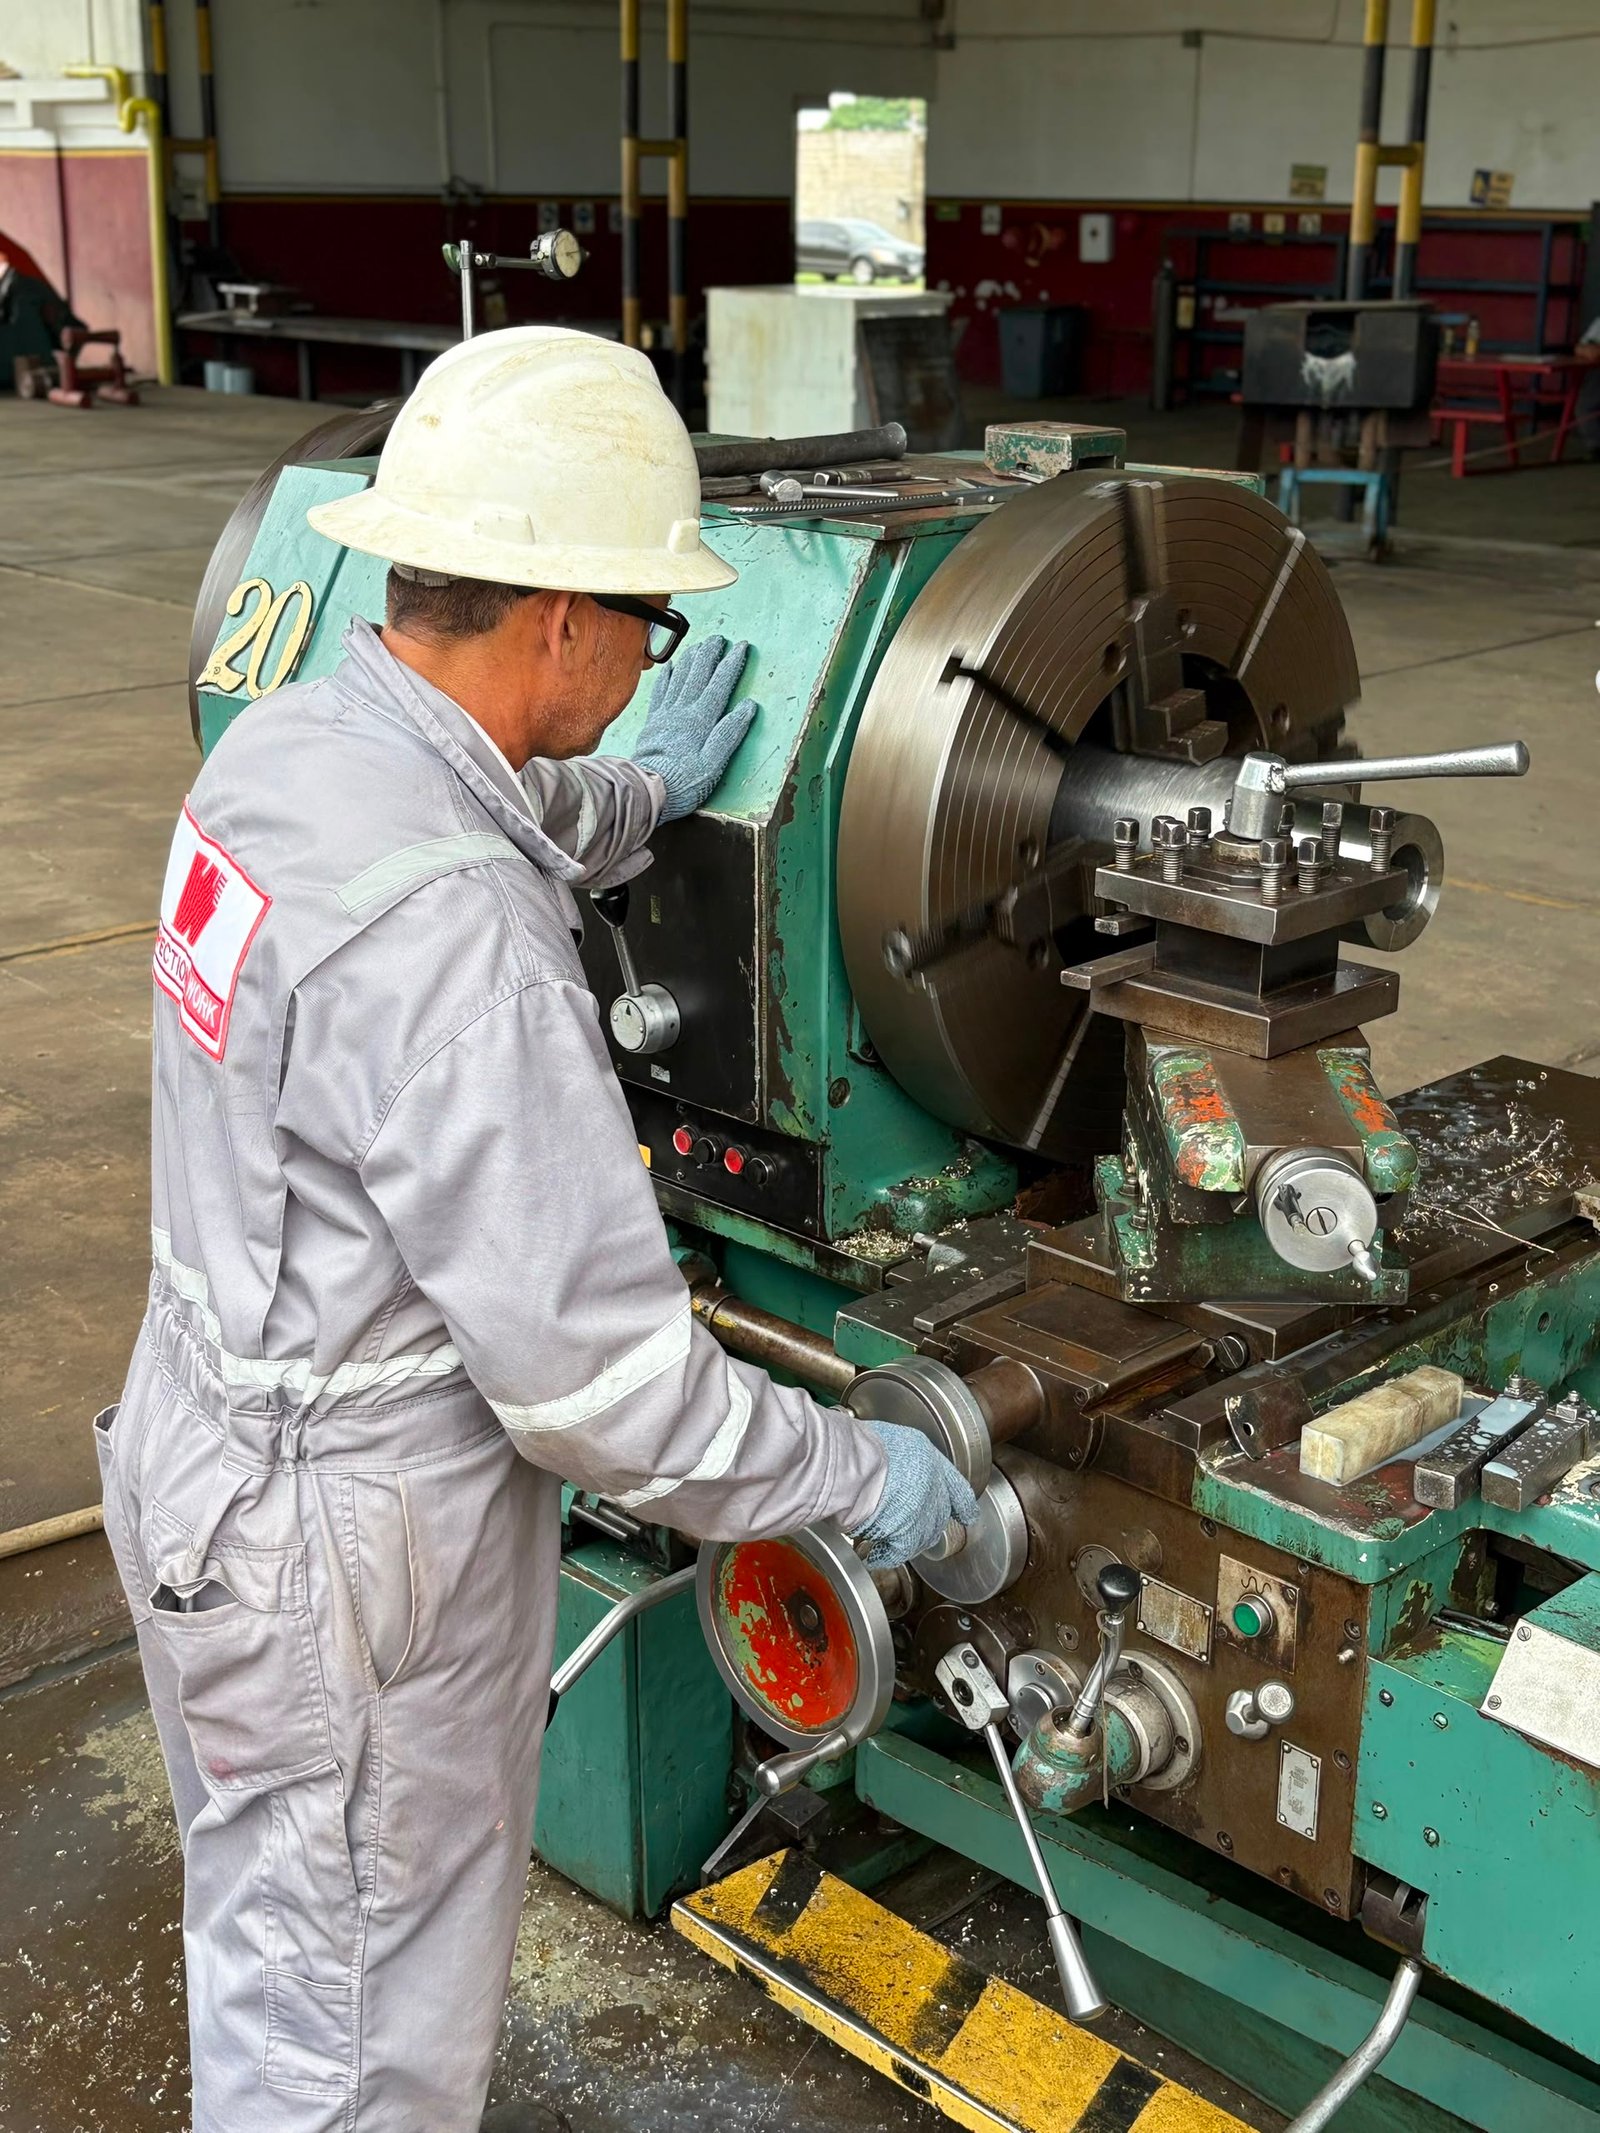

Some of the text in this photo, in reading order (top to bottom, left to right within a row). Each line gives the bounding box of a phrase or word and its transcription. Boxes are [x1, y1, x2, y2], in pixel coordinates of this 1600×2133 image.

[196, 577, 312, 700] 20
[158, 936, 219, 1029] ECTIO WORK
